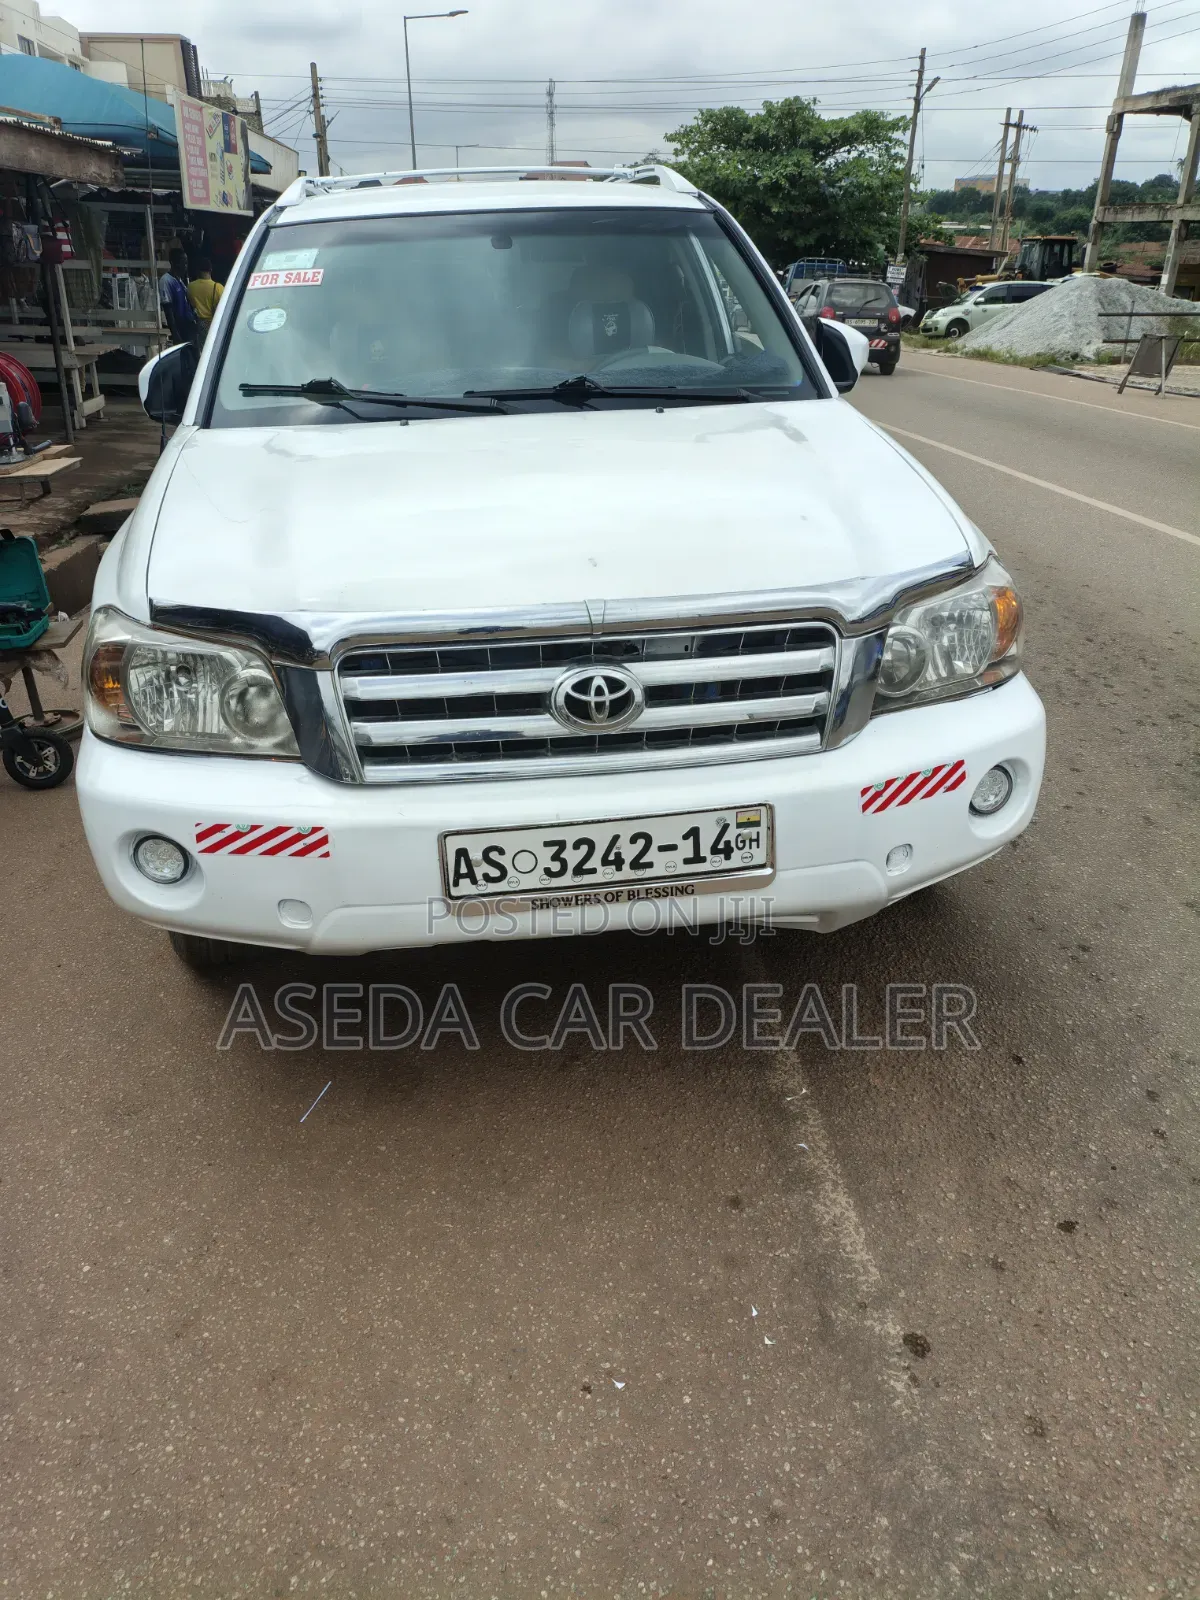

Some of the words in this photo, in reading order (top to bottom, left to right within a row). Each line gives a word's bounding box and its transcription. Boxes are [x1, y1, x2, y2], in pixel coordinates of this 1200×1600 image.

[251, 273, 280, 287] FOR
[283, 271, 321, 285] SALE
[452, 845, 508, 887] AS
[542, 822, 735, 879] 3242-14
[735, 831, 761, 851] GH
[530, 891, 602, 910] SHOWERS
[604, 890, 624, 903] OF
[627, 885, 695, 901] BLESSING
